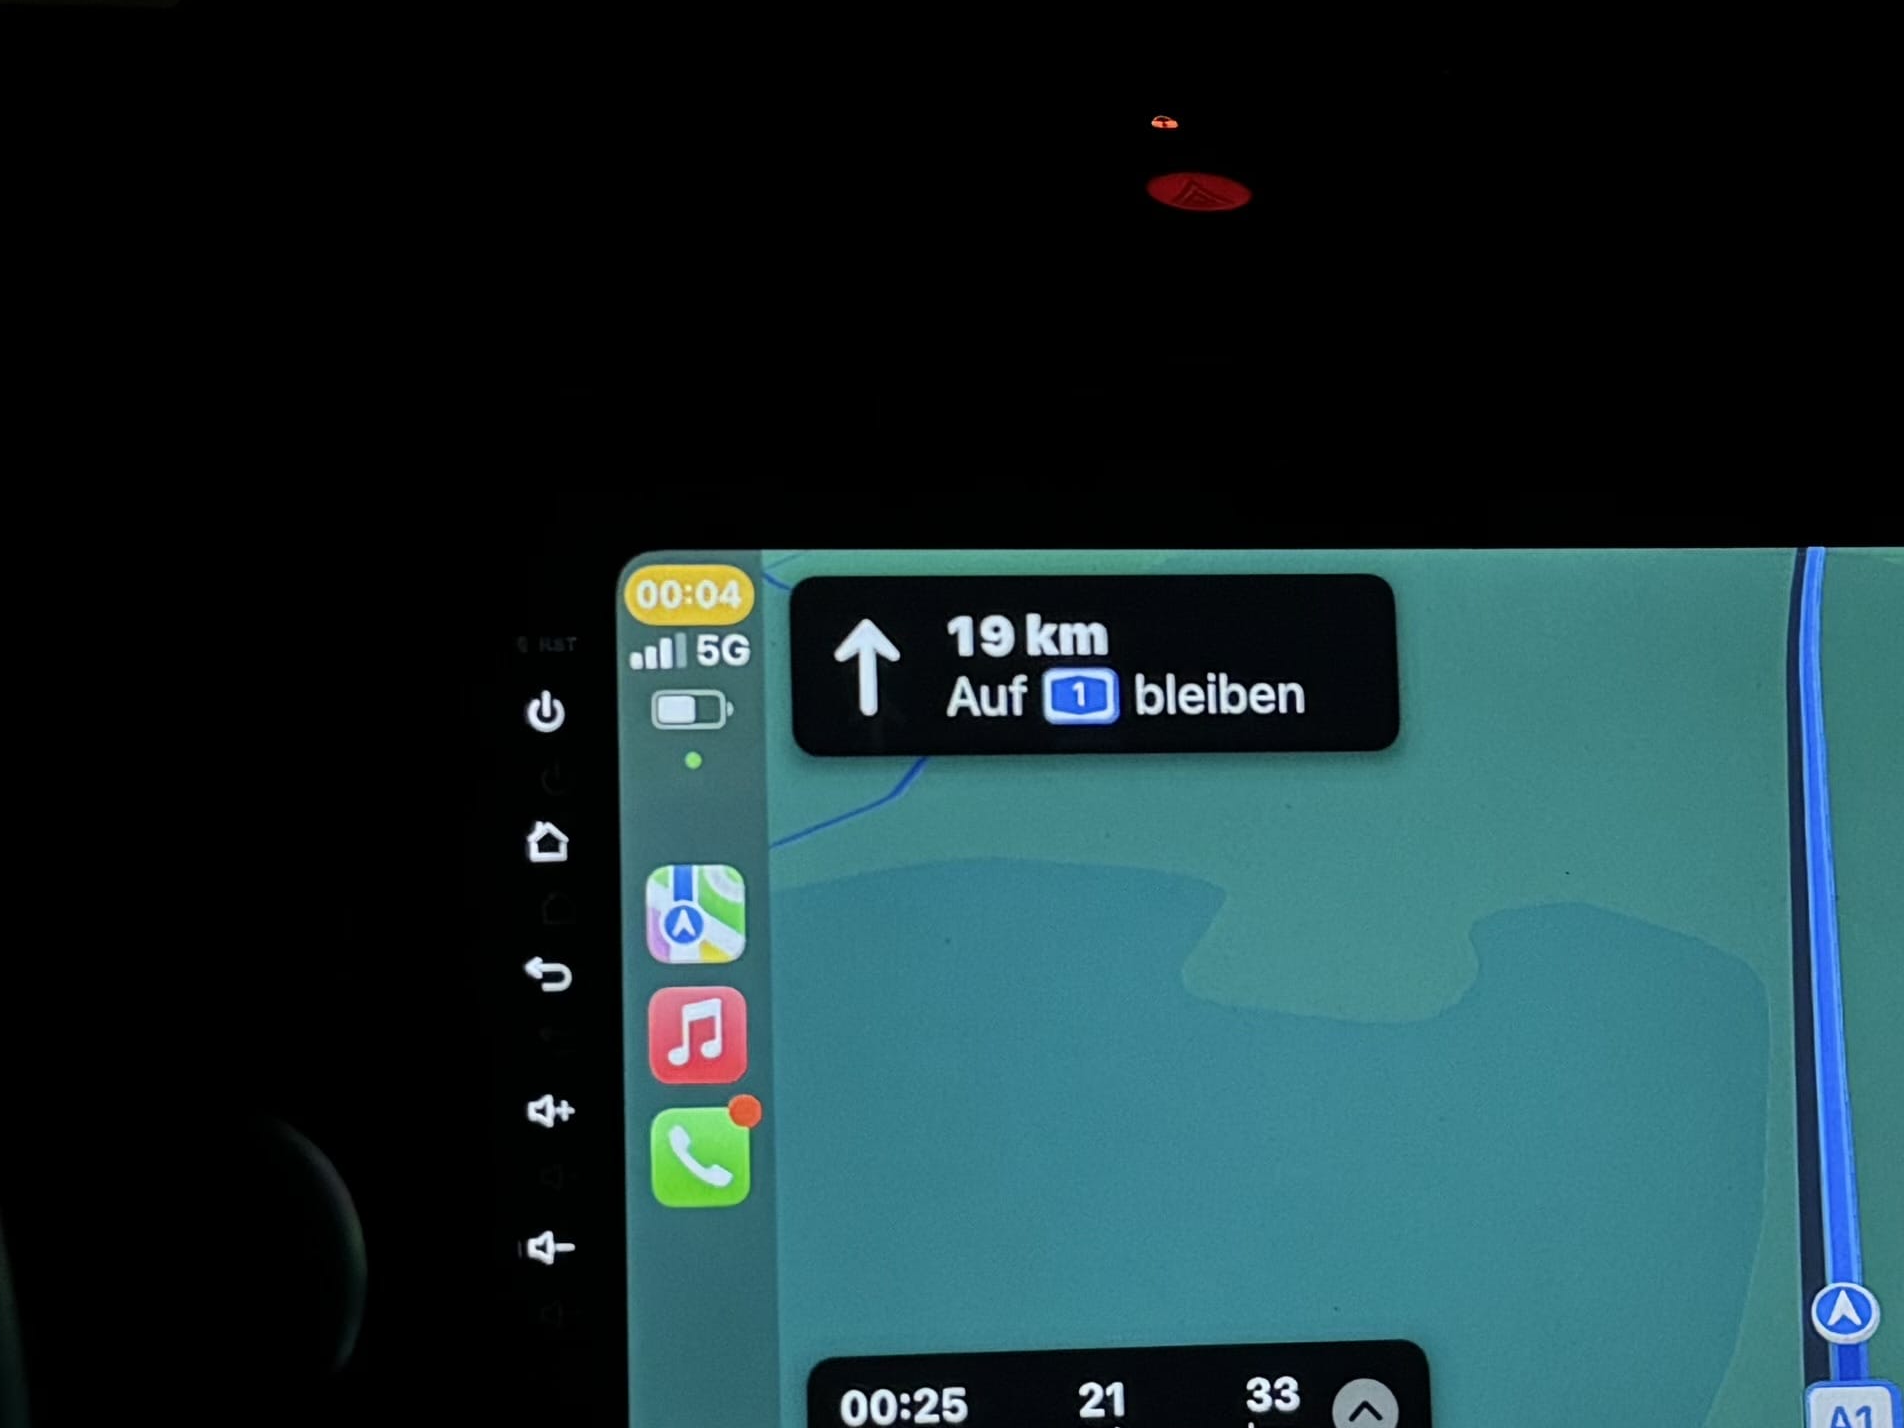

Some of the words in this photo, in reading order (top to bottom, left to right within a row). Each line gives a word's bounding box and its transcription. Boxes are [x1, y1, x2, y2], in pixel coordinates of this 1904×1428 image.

[634, 577, 743, 612] 00:04
[696, 634, 751, 667] 5G
[946, 614, 1016, 659] 19
[1025, 612, 1110, 658] km
[946, 673, 1029, 719] Auf
[1133, 671, 1306, 716] bleiben
[839, 1386, 969, 1428] 00:25
[1077, 1380, 1126, 1420] 21
[1245, 1375, 1301, 1414] 33
